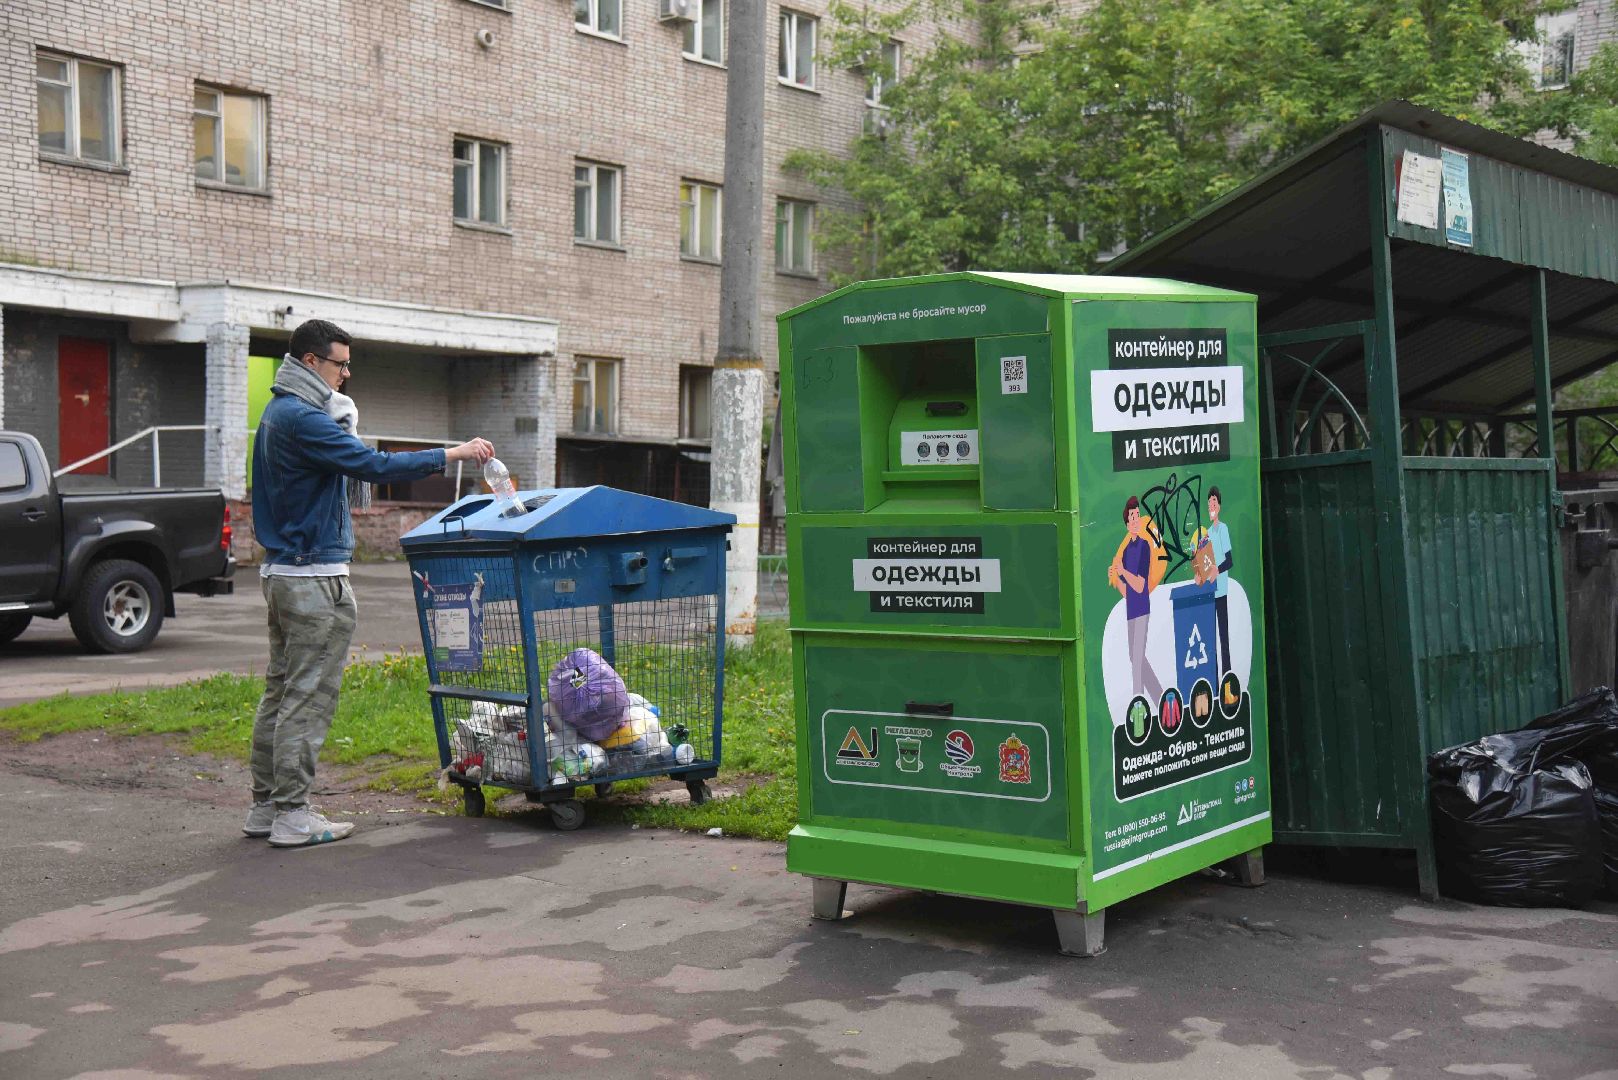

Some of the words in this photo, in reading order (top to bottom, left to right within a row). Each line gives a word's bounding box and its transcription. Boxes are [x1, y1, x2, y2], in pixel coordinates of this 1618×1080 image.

[843, 312, 897, 324] Пожалуйста
[899, 311, 911, 320] не
[912, 306, 956, 320] бросайте
[957, 304, 987, 315] мусор
[1115, 335, 1195, 361] контейнер
[1197, 339, 1222, 358] для
[1114, 379, 1226, 418] одежды
[1125, 439, 1137, 459] и
[1142, 433, 1220, 458] текстиля
[873, 541, 947, 556] контейнер
[950, 543, 976, 554] для
[872, 565, 981, 586] одежды
[880, 595, 891, 607] и
[896, 595, 973, 608] текстиля
[1123, 750, 1163, 771] Одежда
[1168, 740, 1198, 758] Обувь
[1204, 727, 1245, 747] Текстиль
[1122, 769, 1153, 786] Можете
[1154, 758, 1191, 776] положить
[1191, 752, 1208, 765] свои
[1209, 747, 1228, 759] вещи
[1228, 741, 1246, 753] сюда
